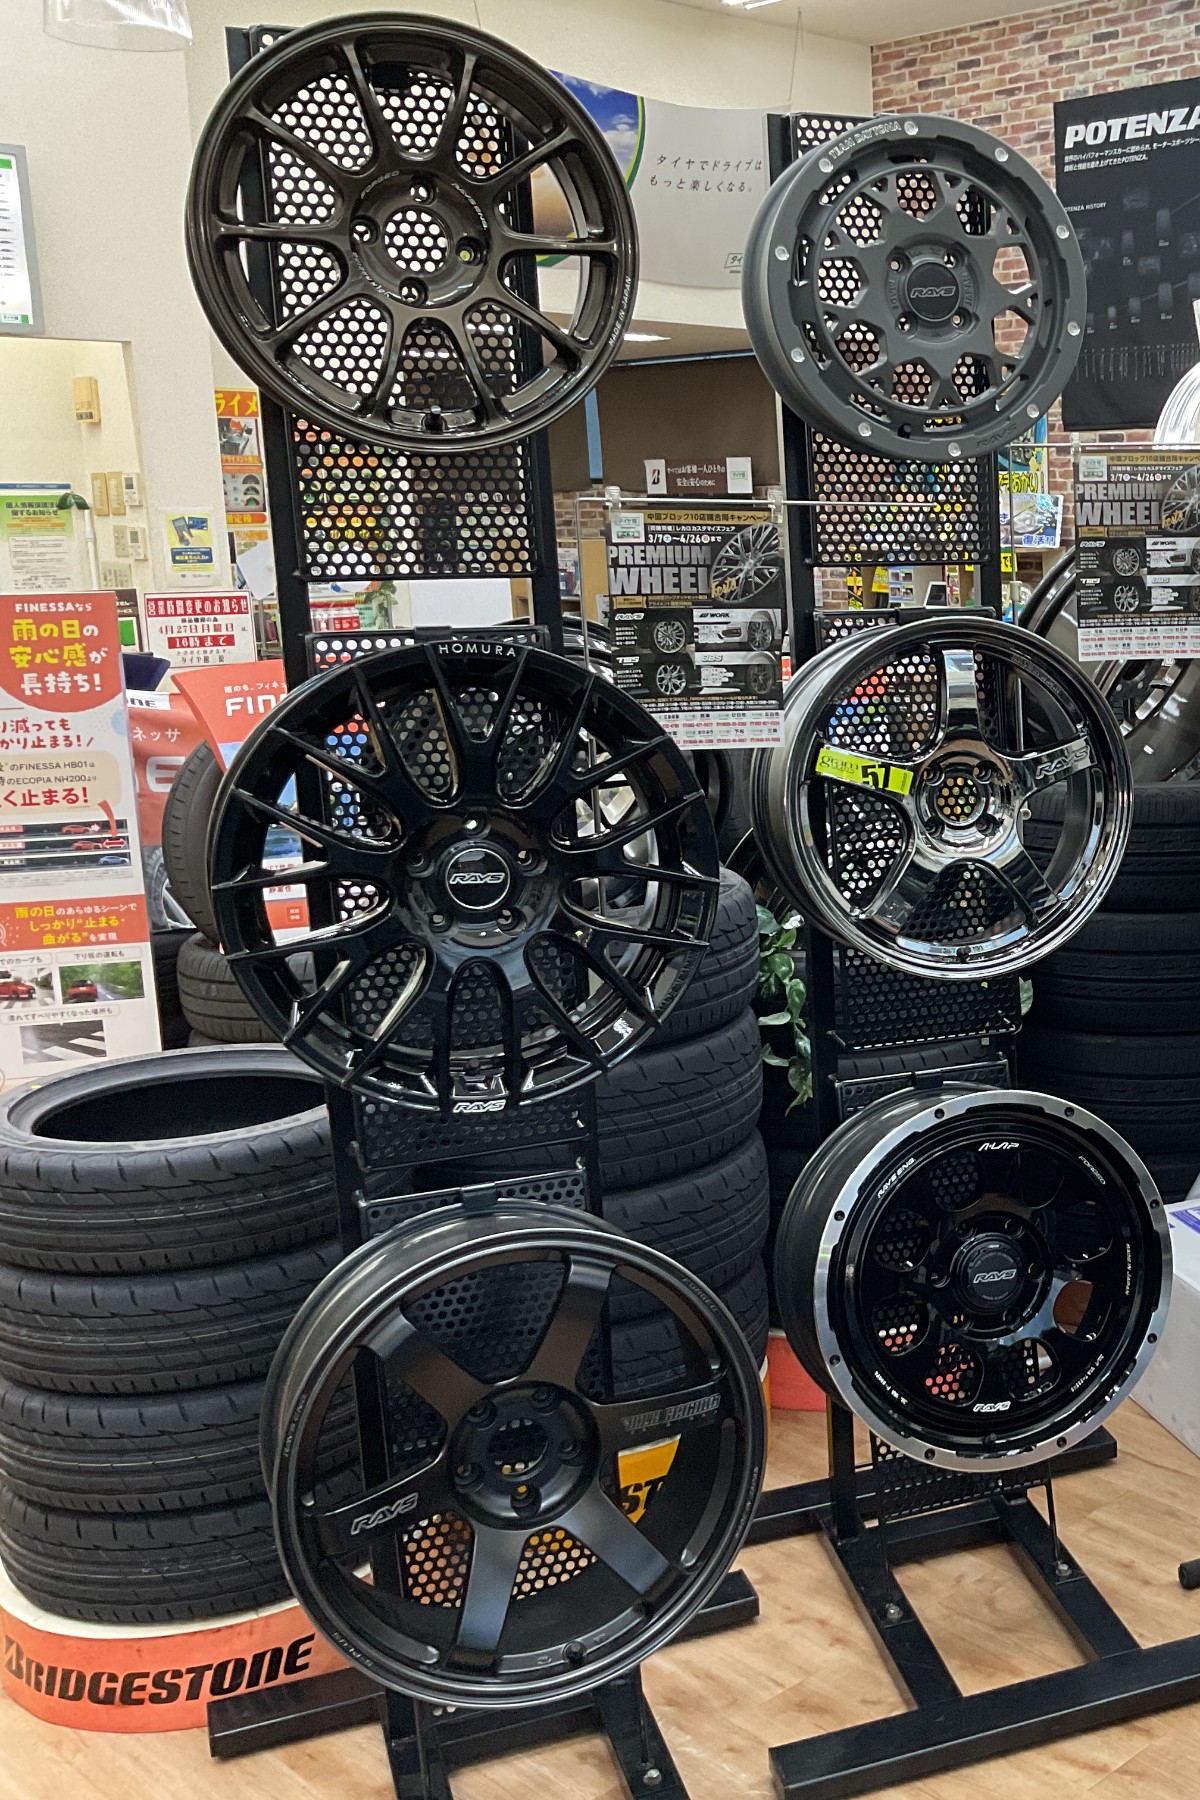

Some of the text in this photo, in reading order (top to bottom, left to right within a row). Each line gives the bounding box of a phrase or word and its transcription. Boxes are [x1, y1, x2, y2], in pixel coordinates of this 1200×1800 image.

[828, 121, 902, 159] TEAM DAYTONA
[656, 155, 763, 172] タイヤでドライブは
[650, 174, 752, 193] もっと楽しくなる。
[910, 285, 956, 299] RAYS
[1076, 484, 1161, 500] PREMIUM
[1076, 502, 1161, 526] WHEEL
[608, 546, 712, 566] PREMIUM
[609, 567, 711, 595] WHEEL
[15, 602, 93, 613] FINESSAなら
[148, 599, 249, 616] 営業時間変更のお知らせ
[12, 618, 99, 641] 雨の日の
[175, 636, 228, 647] 16時まで
[438, 642, 518, 658] HOMURA
[9, 645, 109, 669] 安心感が
[21, 672, 103, 696] 長持ち!
[132, 727, 181, 743] ネッサ
[1035, 744, 1091, 780] RAYS
[0, 786, 89, 808] く止まる!
[448, 872, 506, 886] RAYS
[452, 1098, 507, 1113] RAYS
[877, 1175, 898, 1199] RAYS
[973, 1269, 1017, 1284] RAYS
[973, 1401, 1012, 1413] RAYS
[349, 1492, 420, 1535] RAYS
[4, 1633, 316, 1707] BRIDGESTONE
